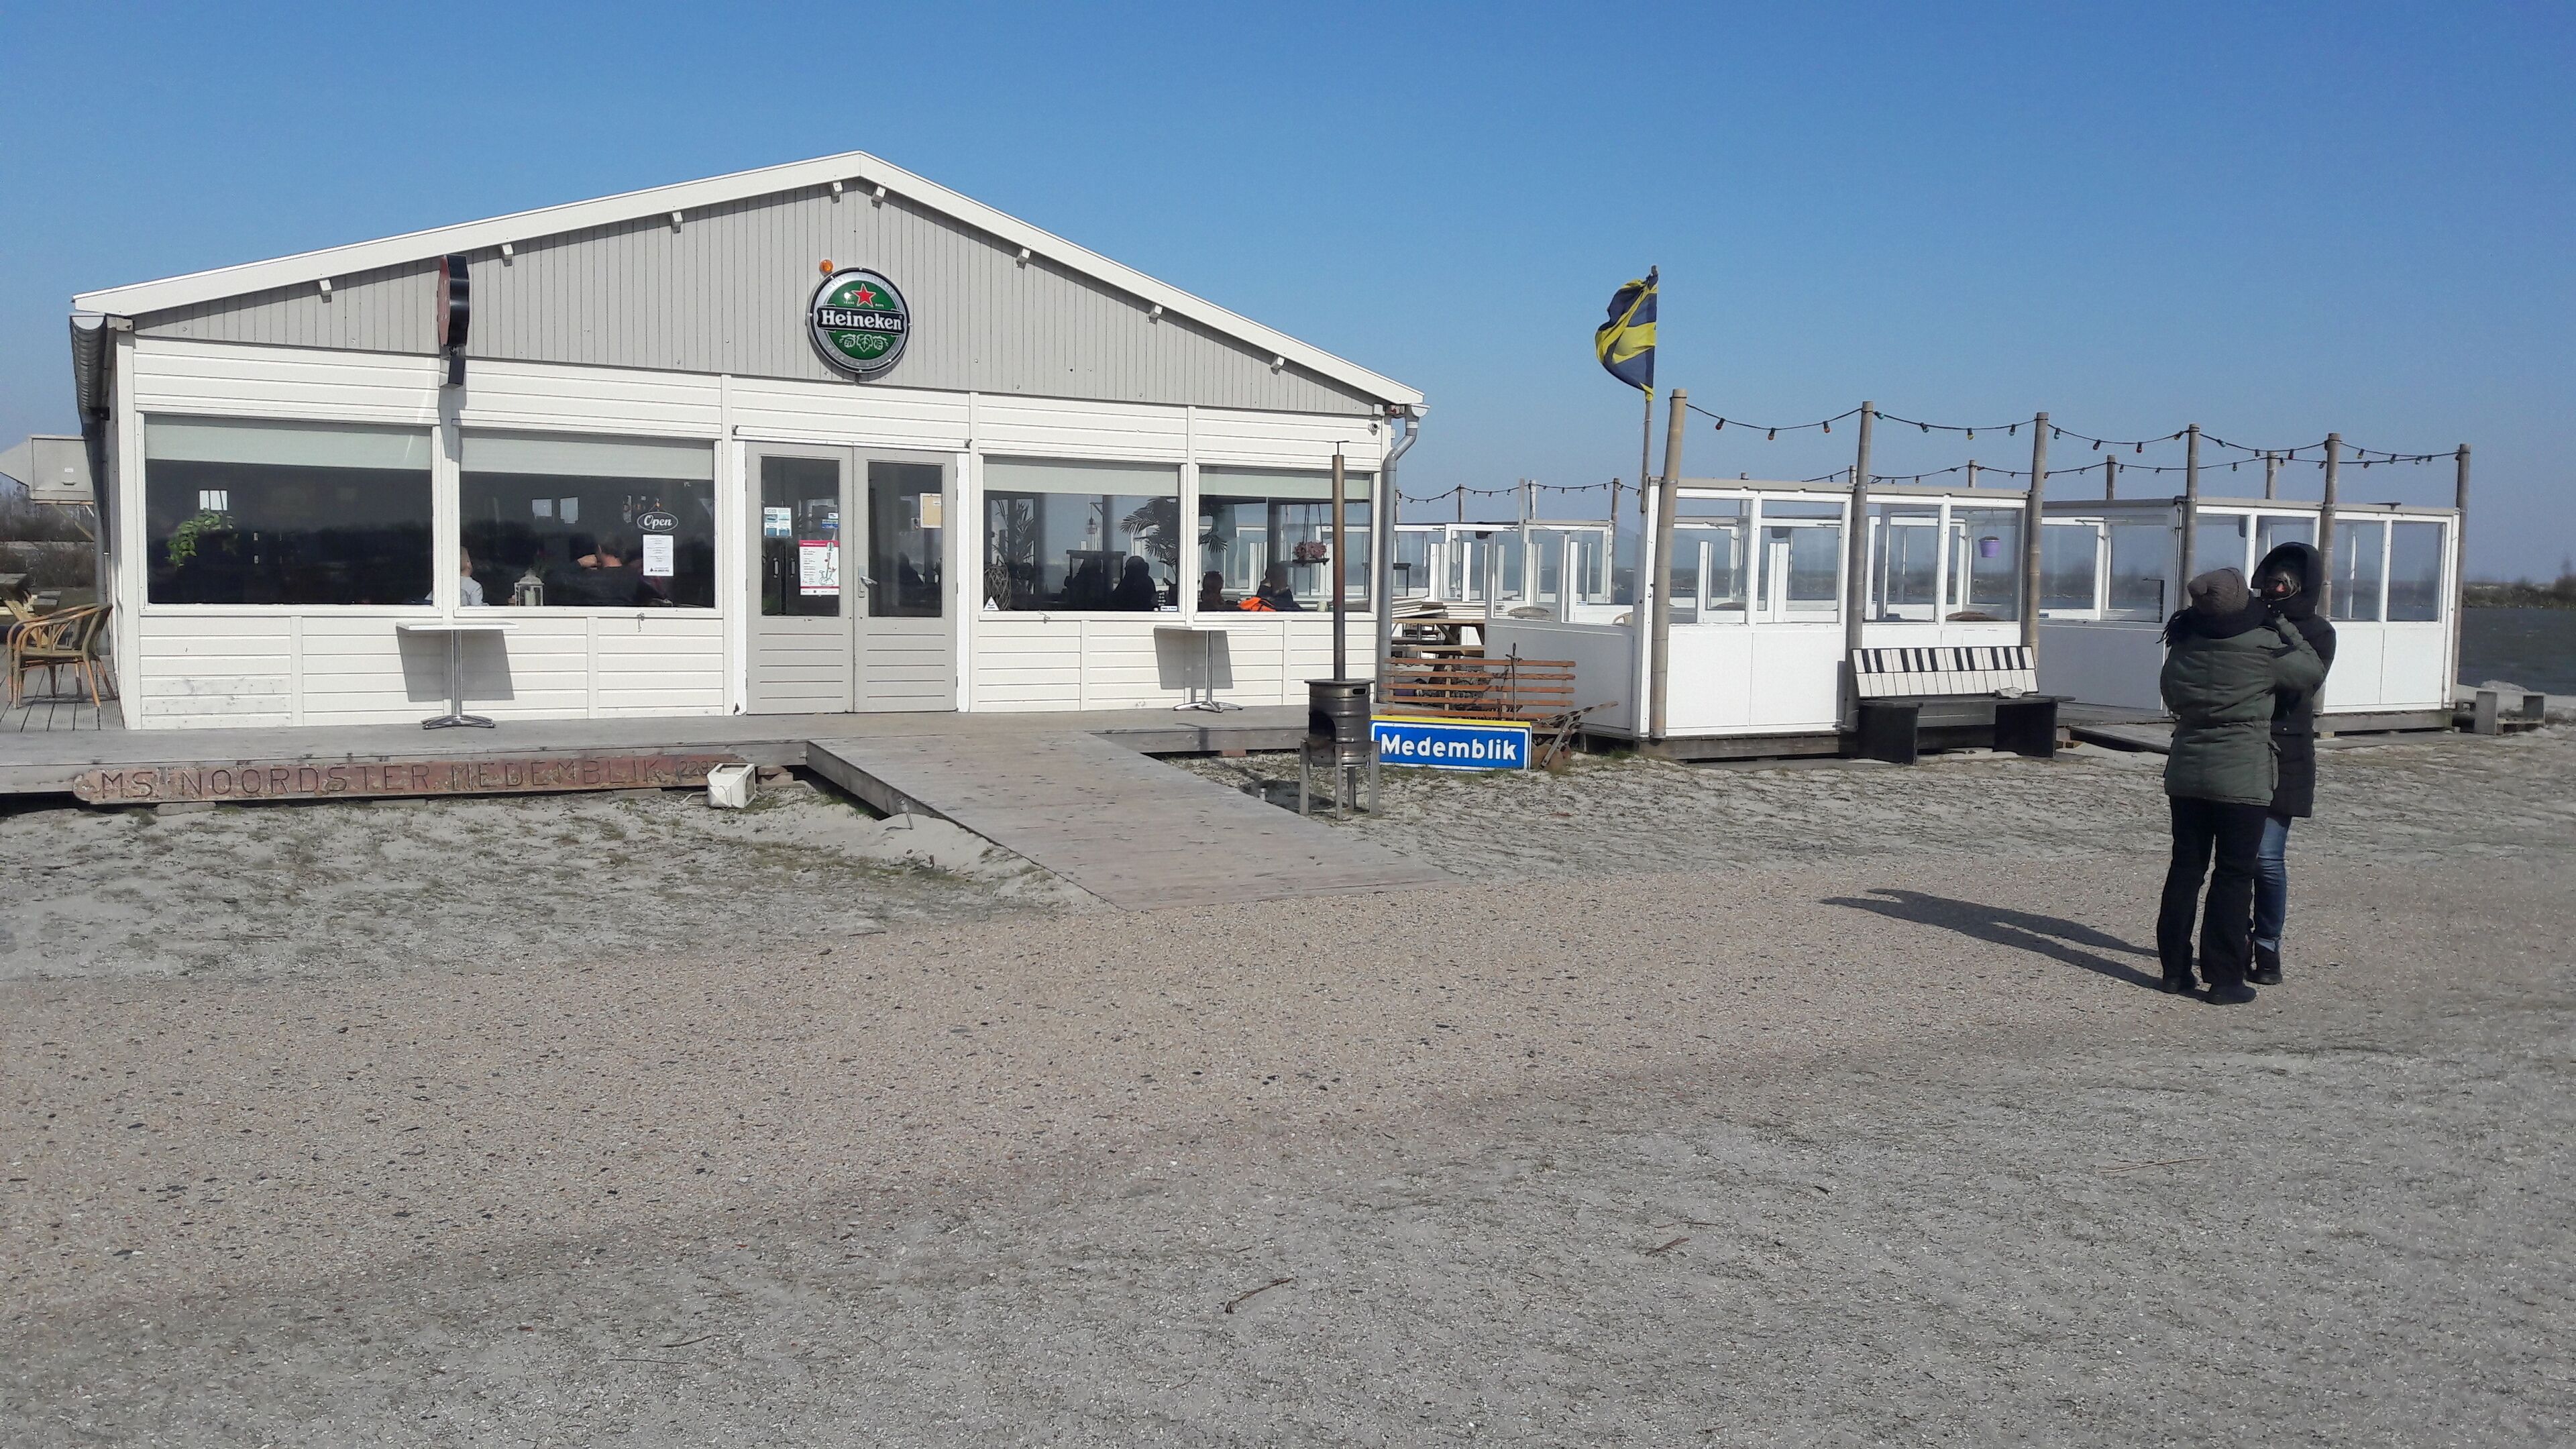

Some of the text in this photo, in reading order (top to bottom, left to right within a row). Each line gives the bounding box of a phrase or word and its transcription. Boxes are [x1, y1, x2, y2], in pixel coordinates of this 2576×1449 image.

[821, 310, 902, 331] Heineken
[643, 515, 673, 530] Open
[1381, 733, 1517, 761] Medemblik
[101, 771, 154, 798] MS
[182, 765, 429, 797] NOORDSTER
[451, 759, 665, 791] MEDEMBLIK
